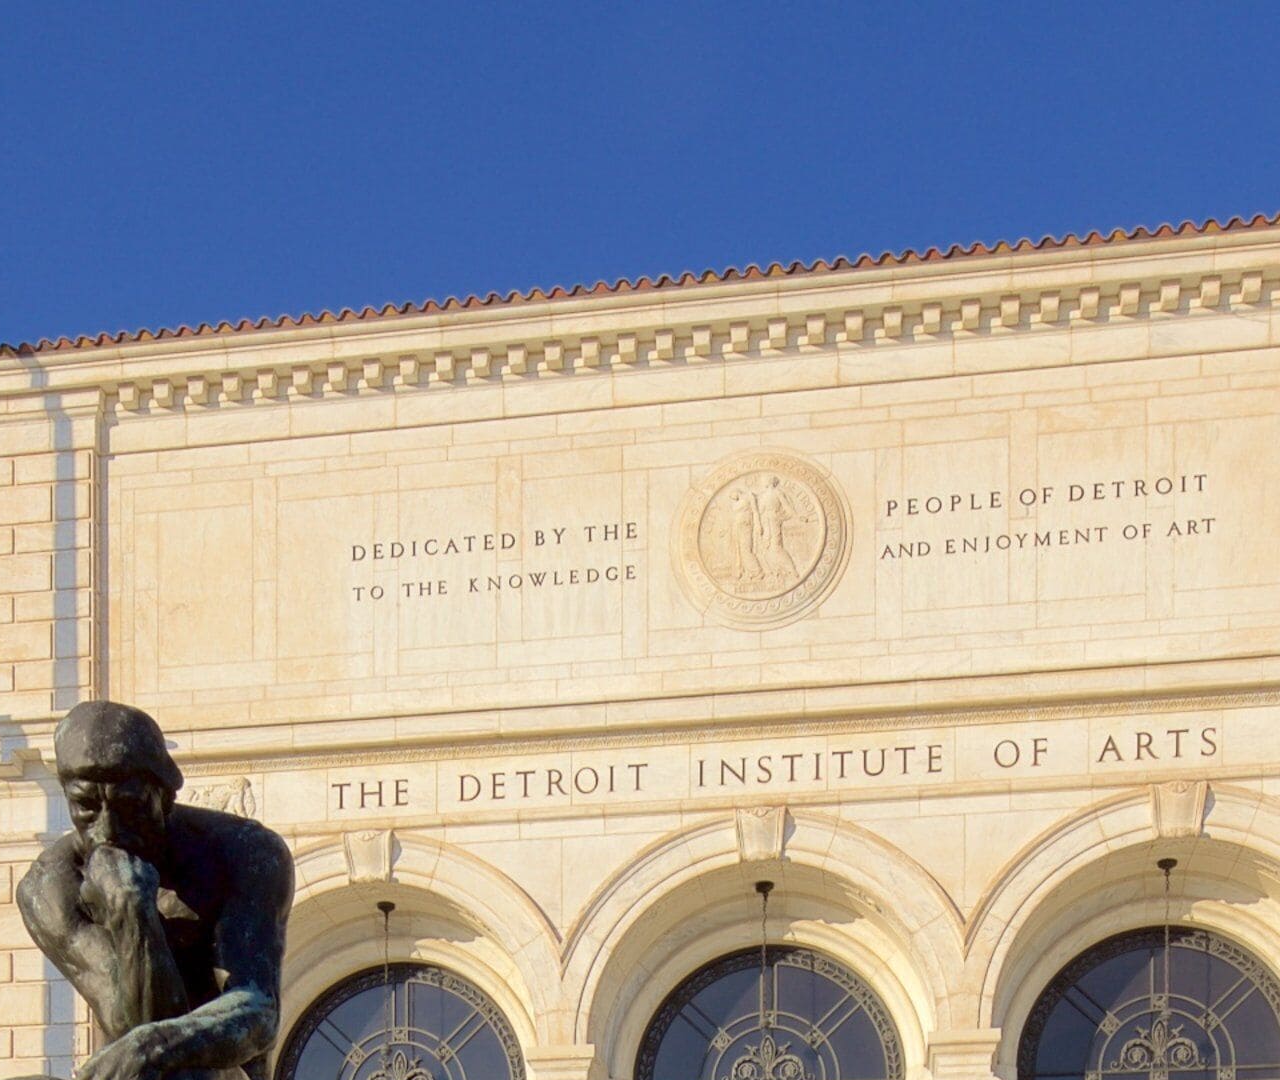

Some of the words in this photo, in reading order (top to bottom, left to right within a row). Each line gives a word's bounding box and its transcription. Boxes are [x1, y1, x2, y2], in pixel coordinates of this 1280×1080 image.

[351, 532, 517, 562] DEDICATED
[533, 527, 567, 547] BY
[582, 522, 639, 543] THE
[886, 491, 1003, 517] PEOPLE
[1019, 486, 1055, 507] OF
[1068, 473, 1209, 503] DETROIT
[351, 585, 386, 602] TO
[401, 580, 449, 598] THE
[468, 564, 637, 593] KNOWLEDGE
[879, 541, 933, 560] AND
[944, 526, 1110, 555] ENJOYMENT
[1122, 523, 1153, 541] OF
[1166, 517, 1217, 537] ART
[330, 778, 410, 811] THE
[458, 763, 650, 803] DETROIT
[697, 744, 944, 788] INSTITUTE
[993, 737, 1049, 769] OF
[1095, 727, 1218, 763] ARTS
